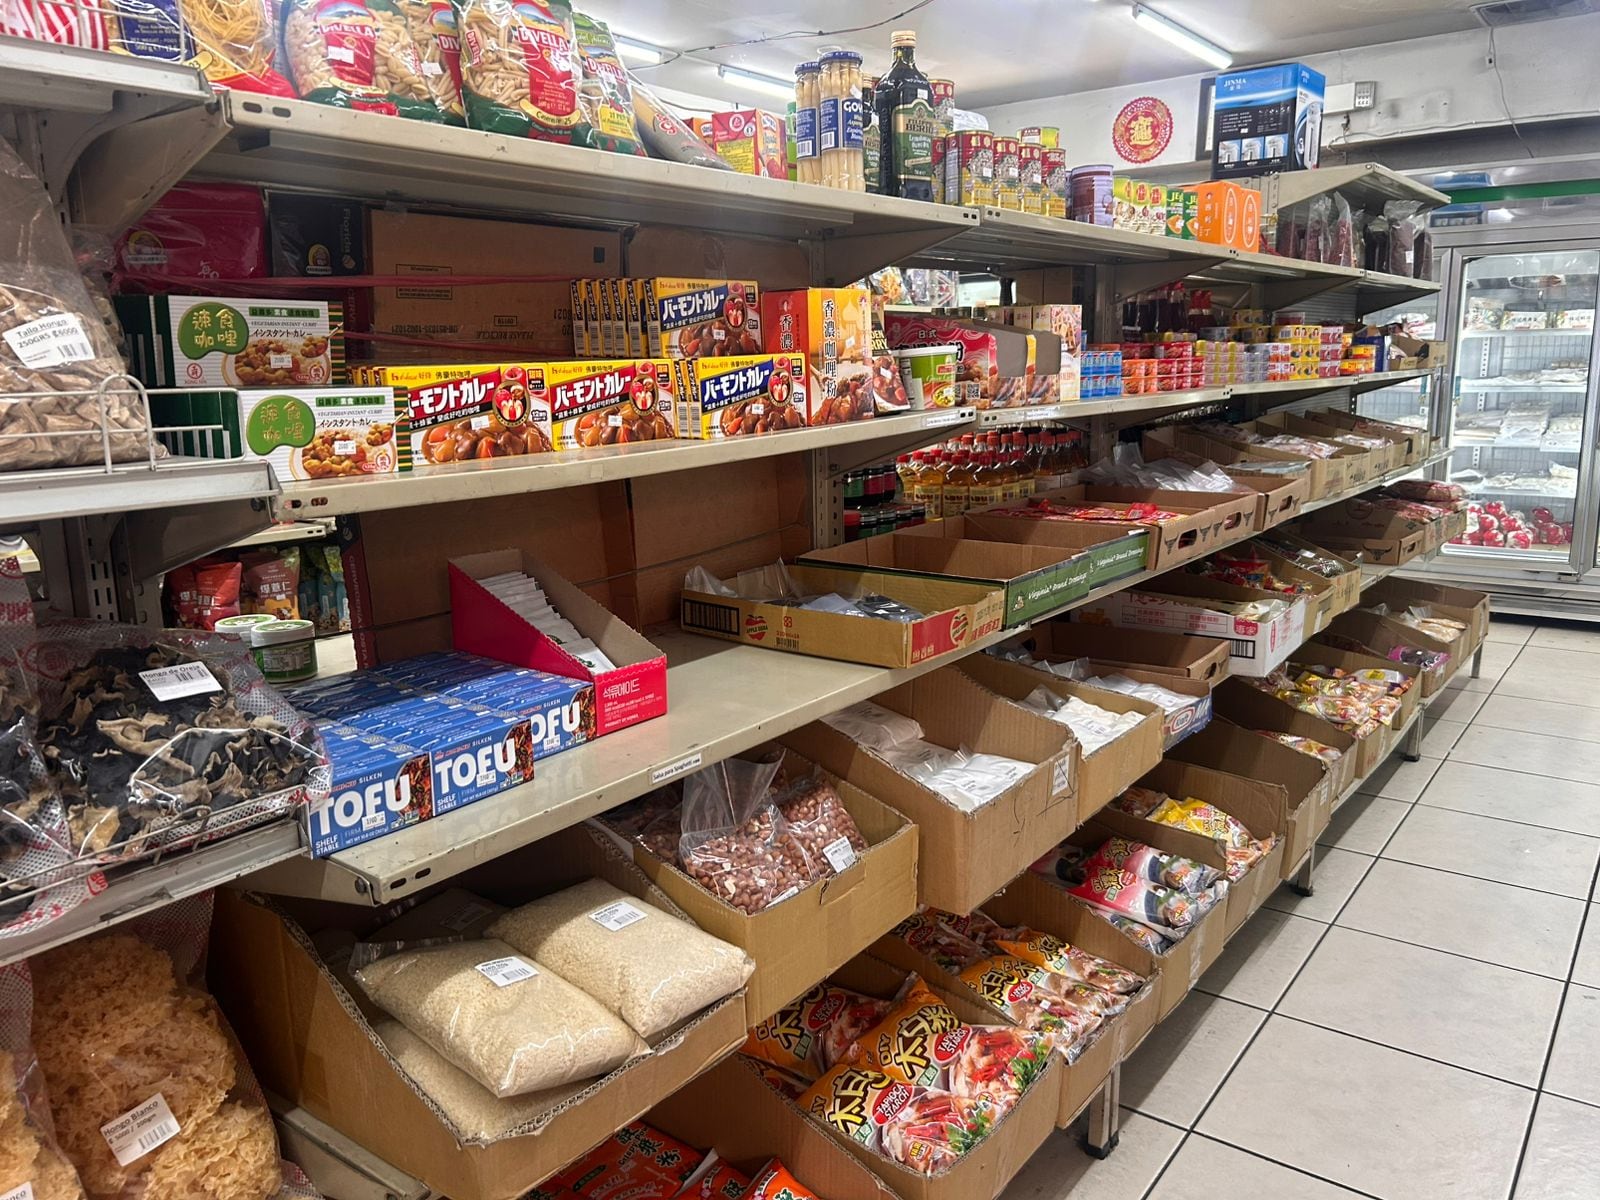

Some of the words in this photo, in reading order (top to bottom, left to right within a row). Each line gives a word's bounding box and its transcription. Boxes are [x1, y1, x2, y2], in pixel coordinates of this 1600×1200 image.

[322, 23, 375, 38] DIVELLA
[662, 289, 725, 321] バーモントカレー
[16, 326, 38, 338] Tallo
[194, 330, 237, 348] 咖哩
[823, 300, 837, 398] 香濃咖哩粉
[554, 371, 631, 410] バーモントカレー
[704, 366, 770, 402] バーモントカレー
[142, 670, 168, 679] Hongo
[179, 664, 200, 673] Oreja
[531, 701, 580, 744] OFU
[472, 736, 492, 747] SILKEN
[359, 772, 382, 784] SILKEN
[435, 738, 516, 794] TOFU
[312, 774, 411, 836] TOFU
[437, 793, 456, 806] SHELF
[438, 801, 457, 812] STABLE
[315, 835, 338, 849] SHELF
[316, 843, 339, 856] STABLE
[879, 1033, 893, 1066] DIY
[877, 1083, 905, 1114] TAPIOCA
[884, 1090, 910, 1120] STARCH
[103, 1118, 131, 1137] Hongo
[130, 1100, 158, 1121] Blanco
[618, 1139, 639, 1167] Crispy
